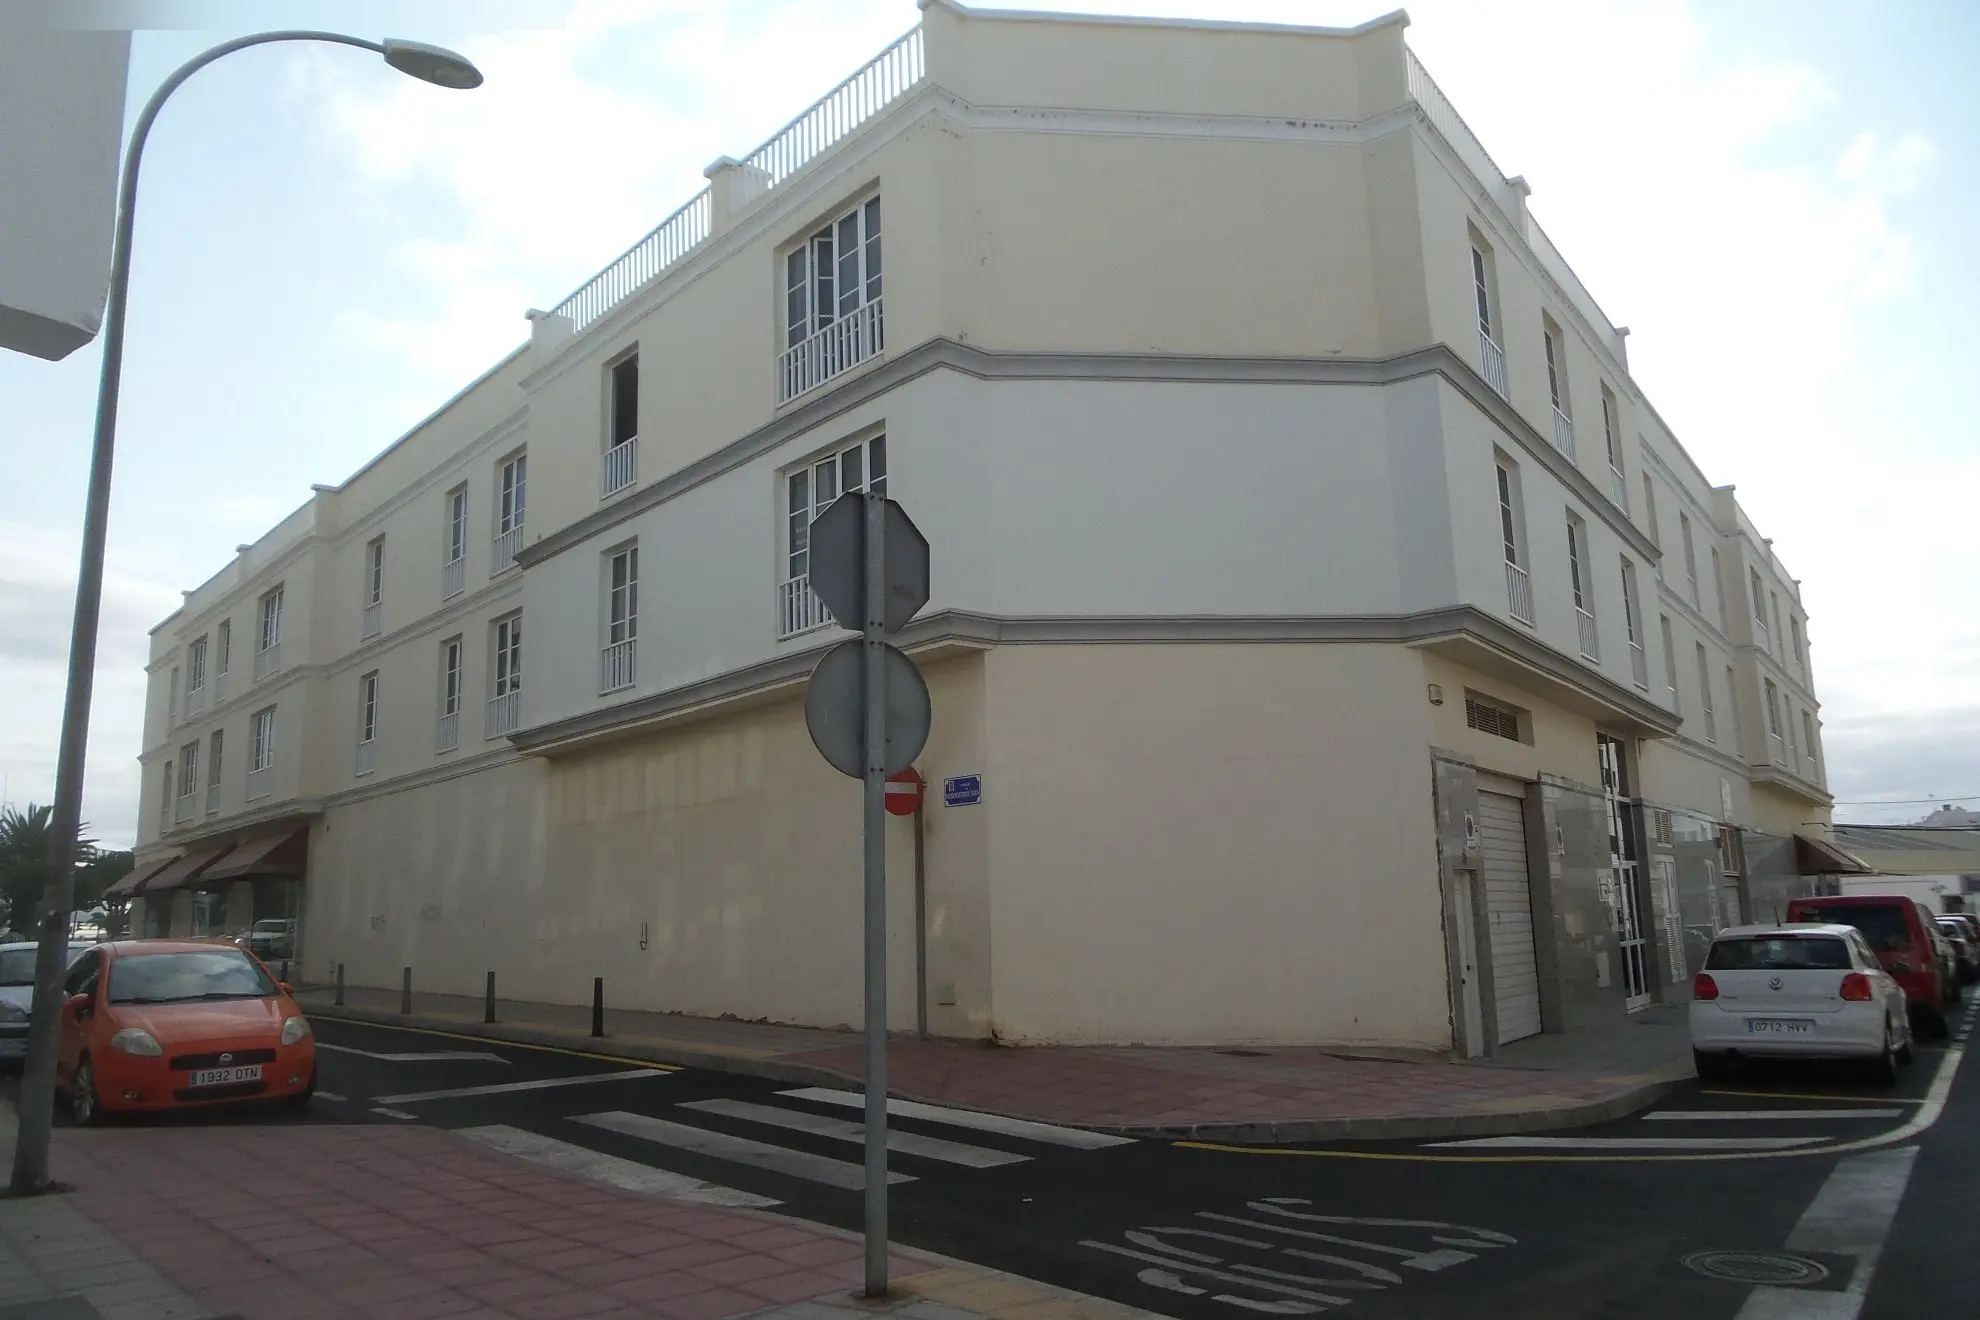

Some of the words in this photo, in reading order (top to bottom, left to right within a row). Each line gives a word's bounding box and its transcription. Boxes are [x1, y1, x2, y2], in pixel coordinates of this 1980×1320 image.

[1755, 1022, 1782, 1033] 0712
[201, 1070, 230, 1083] 1932
[236, 1067, 258, 1080] DTN
[1077, 1197, 1518, 1314] STOP
